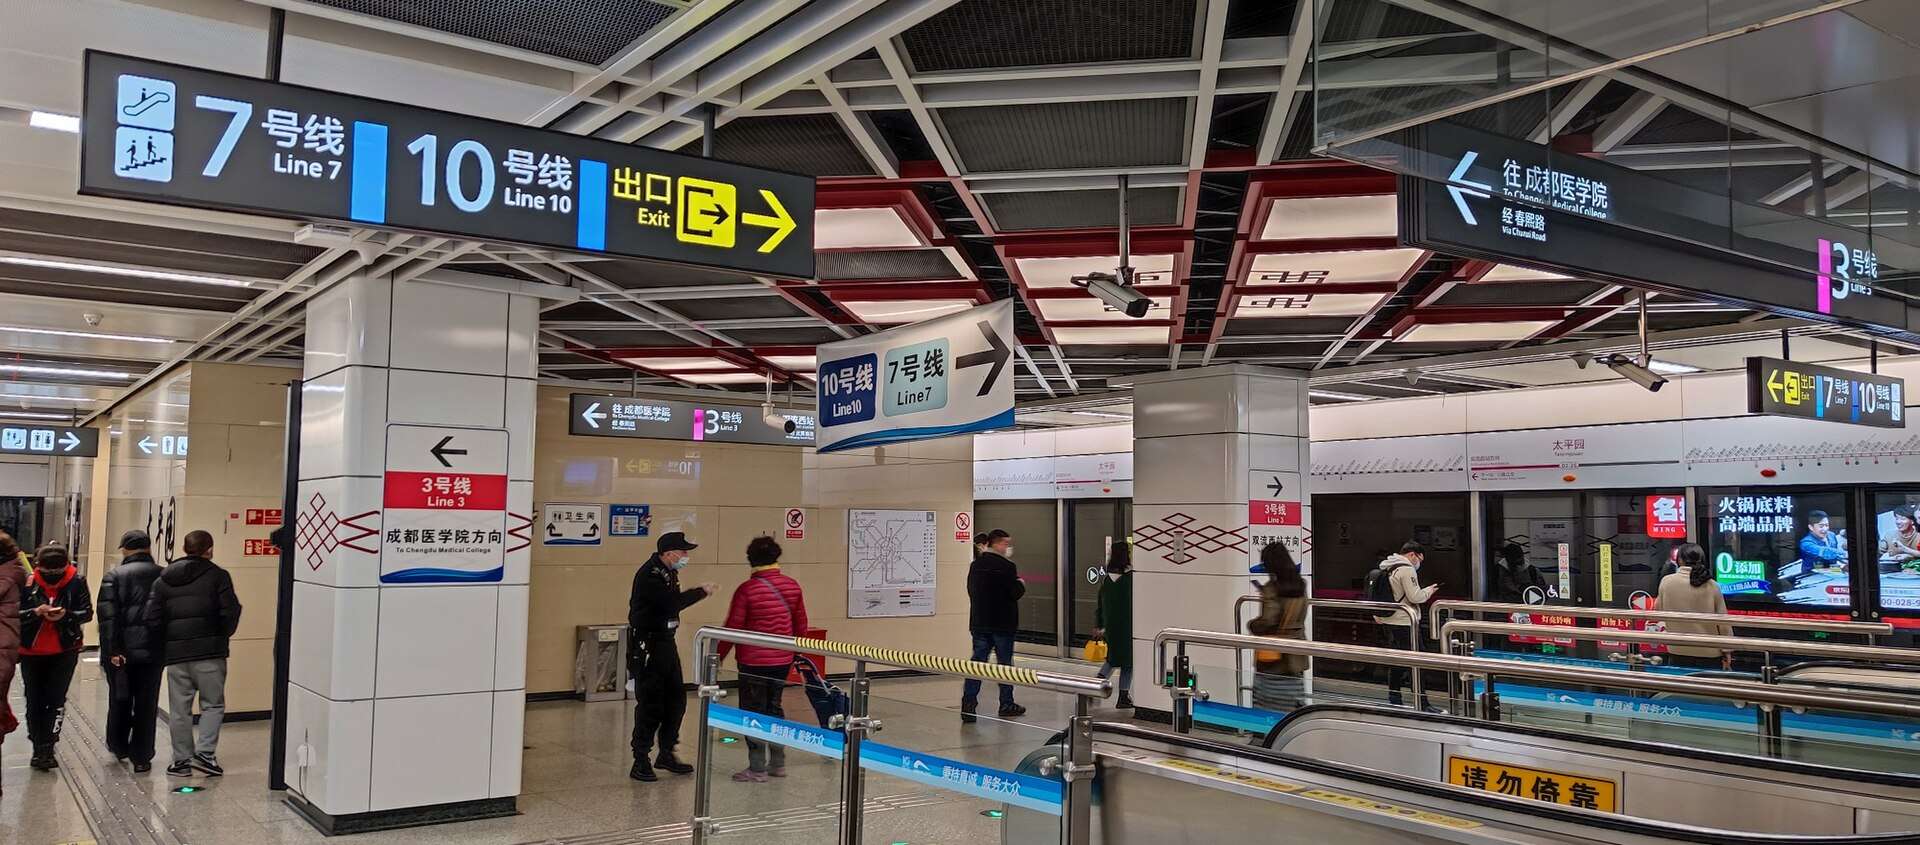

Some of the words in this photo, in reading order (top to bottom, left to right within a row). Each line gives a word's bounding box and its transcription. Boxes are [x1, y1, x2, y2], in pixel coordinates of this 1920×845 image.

[196, 96, 252, 177] 7
[261, 108, 344, 156] 号线
[274, 153, 322, 178] Line
[328, 161, 342, 180] 7
[407, 134, 496, 213] 10
[503, 148, 573, 192] 号线
[613, 166, 672, 205] 出口
[1503, 158, 1521, 188] 往
[1525, 165, 1608, 209] 成都医学院
[504, 187, 546, 211] Line
[550, 194, 571, 214] 10
[638, 207, 670, 228] Exit
[1502, 207, 1513, 224] 经
[1514, 210, 1545, 231] 春熙路
[1502, 226, 1512, 235] Via
[1532, 231, 1547, 242] Road
[1832, 242, 1849, 300] 3
[888, 348, 944, 384] 7号线
[822, 362, 873, 397] 10号线
[1824, 376, 1834, 408] 7
[1859, 382, 1876, 413] 10
[705, 409, 720, 434] 3
[721, 411, 743, 424] 号线
[1552, 439, 1584, 451] 太平园
[422, 477, 473, 495] 3号线
[427, 496, 454, 507] Line
[458, 497, 465, 507] 3
[1265, 504, 1286, 516] 3号线
[1718, 496, 1793, 513] 火锅底料
[565, 512, 595, 520] 卫生间
[1719, 516, 1793, 532] 高端品牌
[386, 528, 501, 544] 成都医学院方向
[1735, 561, 1761, 574] 添加
[982, 775, 1021, 798] 服务大众
[1461, 765, 1600, 810] 请勿倚靠
